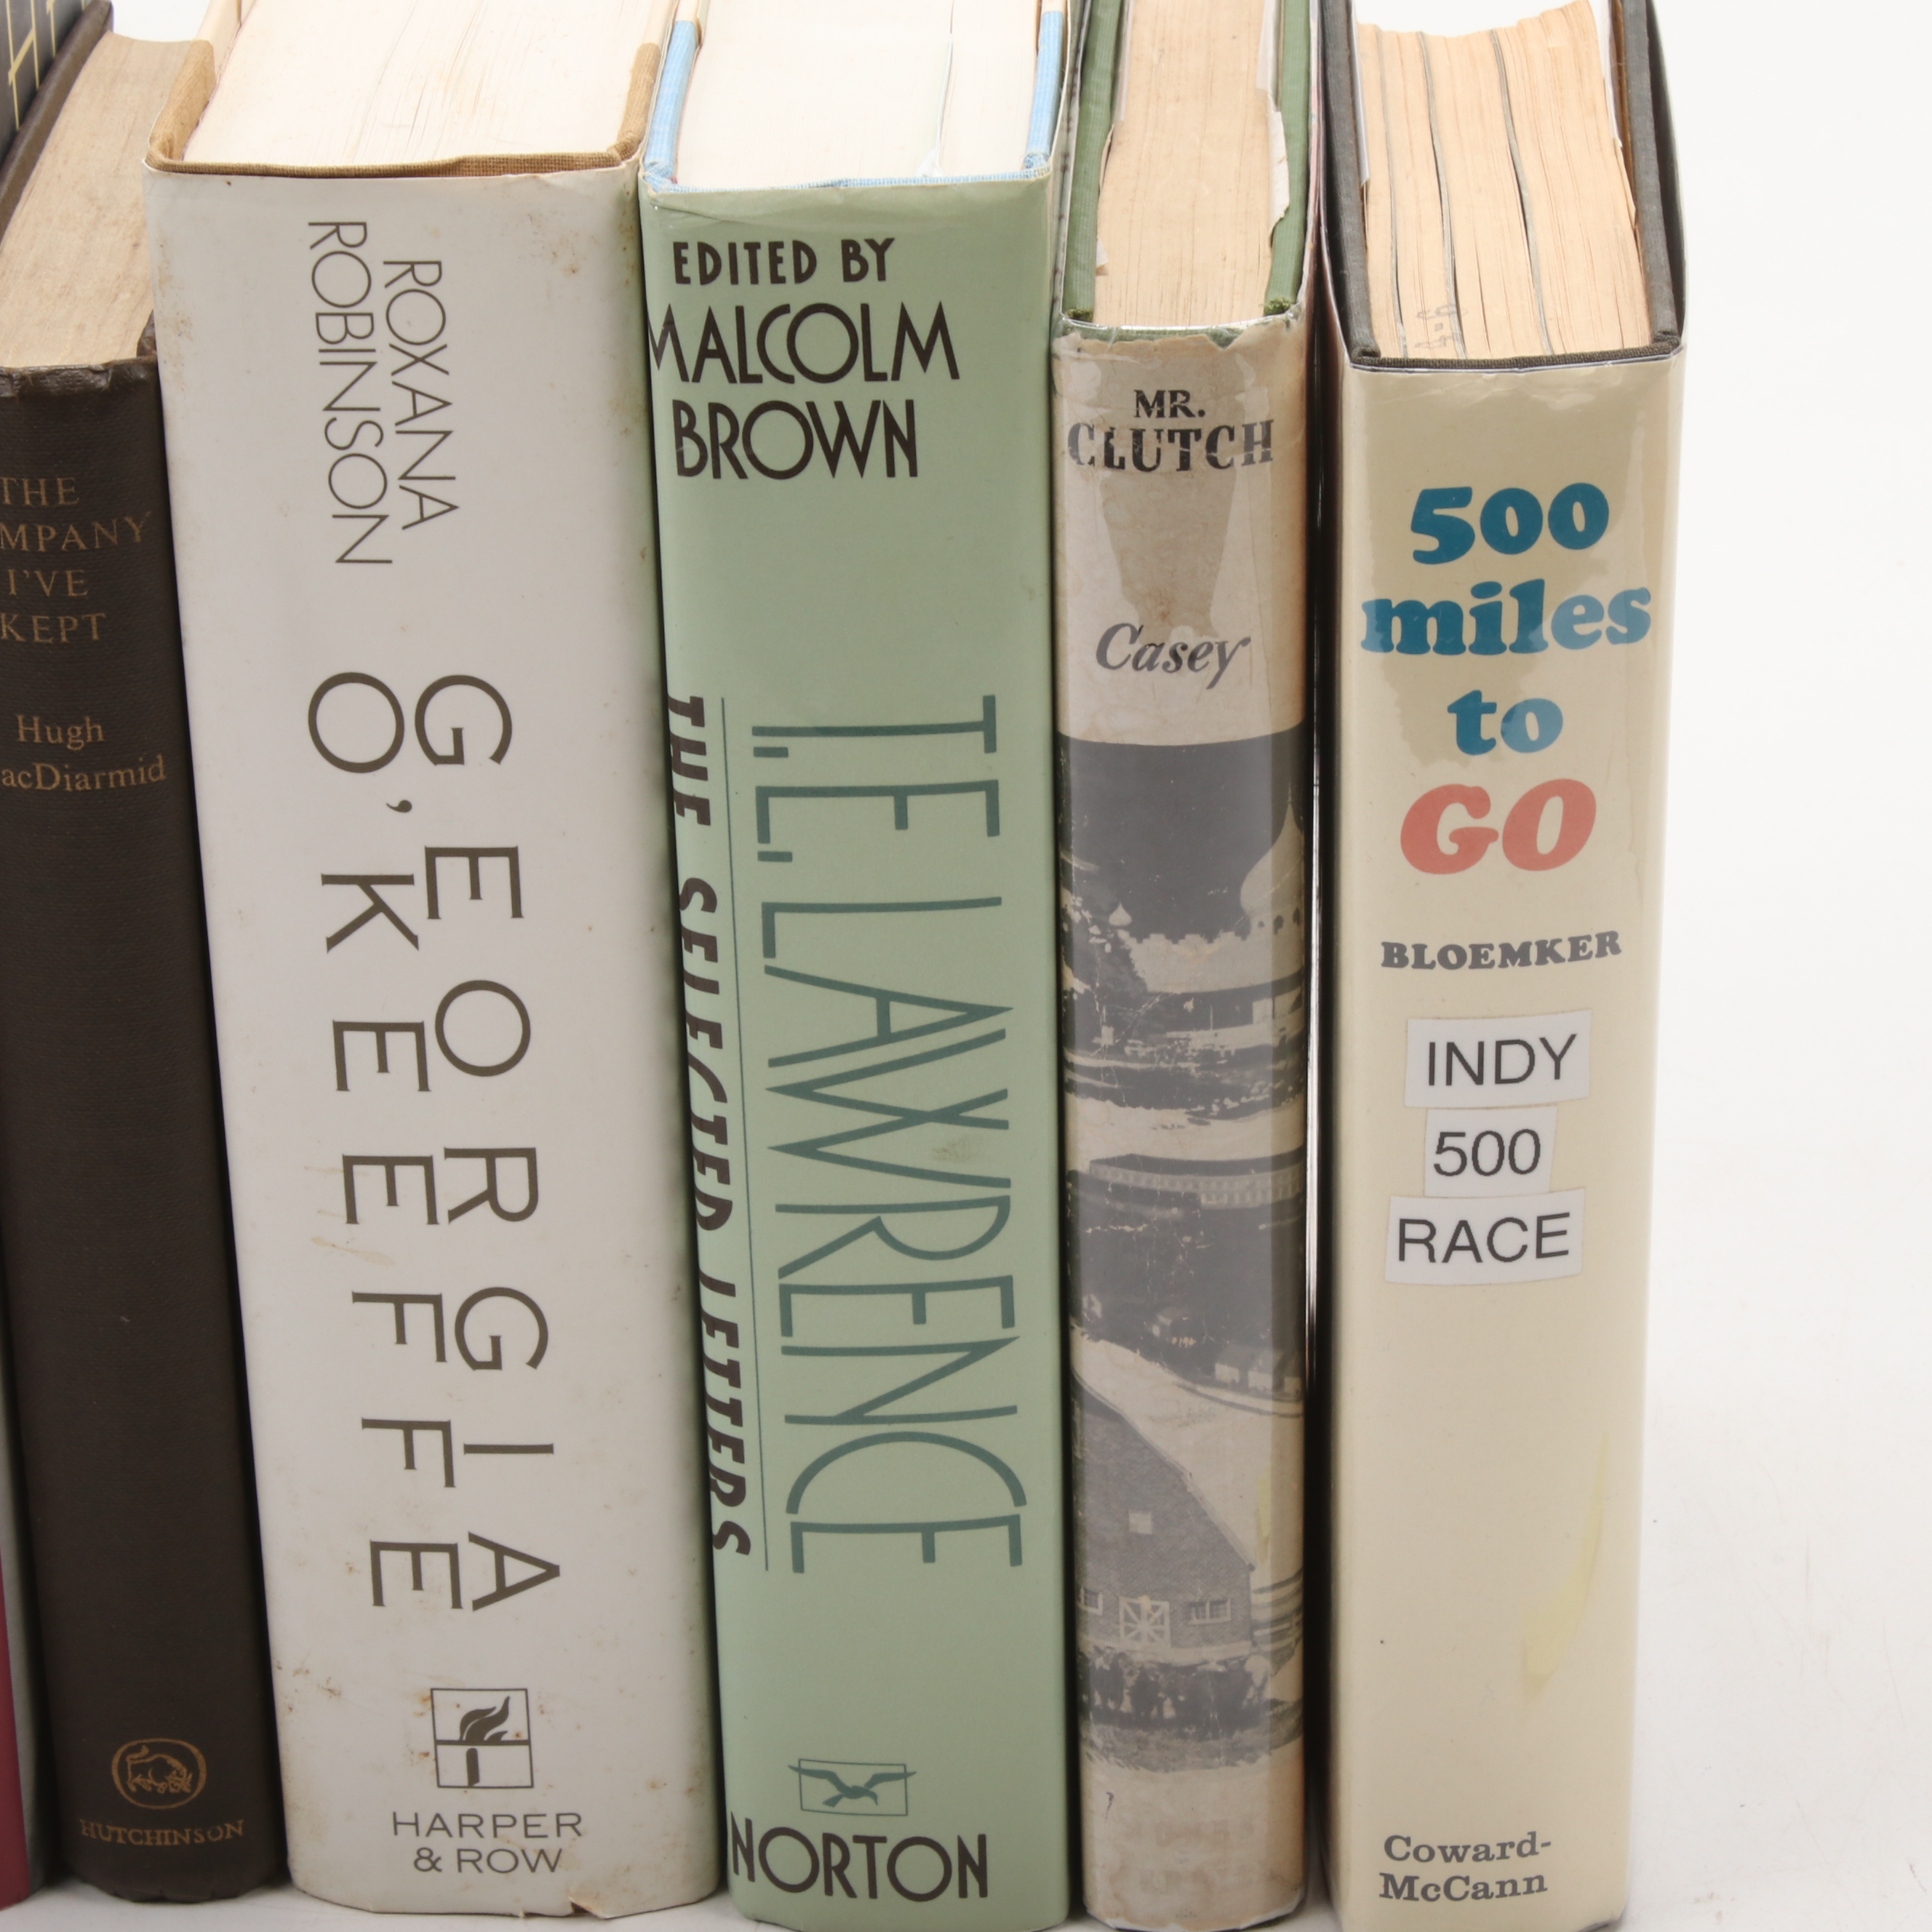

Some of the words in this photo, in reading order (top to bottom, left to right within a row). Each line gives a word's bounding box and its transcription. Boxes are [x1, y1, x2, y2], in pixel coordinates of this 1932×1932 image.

[673, 239, 817, 285] EDITED
[841, 237, 895, 282] BY
[647, 300, 960, 383] MALCOLM
[308, 222, 393, 564] ROBINSON
[383, 260, 460, 530] ROXANA
[1134, 389, 1205, 418] MR.
[672, 399, 918, 480] BROWN
[1068, 419, 1274, 473] CLUTCH
[0, 477, 79, 506] THE
[1410, 482, 1610, 564] 500
[8, 570, 89, 597] I'VE
[0, 612, 106, 643] KEPT
[1360, 578, 1651, 656] miles
[1095, 622, 1251, 690] Casey
[17, 715, 105, 750] Hugh
[1447, 690, 1563, 755] to
[667, 695, 711, 826] THE
[1400, 778, 1597, 874] GO
[1381, 930, 1622, 970] BLOEMKER
[1428, 1034, 1577, 1086] INDY
[308, 671, 463, 1609] O'KEEFFE
[415, 674, 559, 1612] GEORGIA
[1433, 1129, 1541, 1176] 500
[760, 896, 1026, 1574] LAWRENCE
[1398, 1212, 1570, 1264] RACE
[79, 1819, 244, 1846] HUTCHINSON
[393, 1811, 583, 1838] HARPER
[1384, 1831, 1552, 1863] Coward-
[413, 1847, 442, 1872] &
[456, 1848, 562, 1874] ROW
[730, 1811, 988, 1901] NORTON
[1379, 1872, 1548, 1902] McCann
